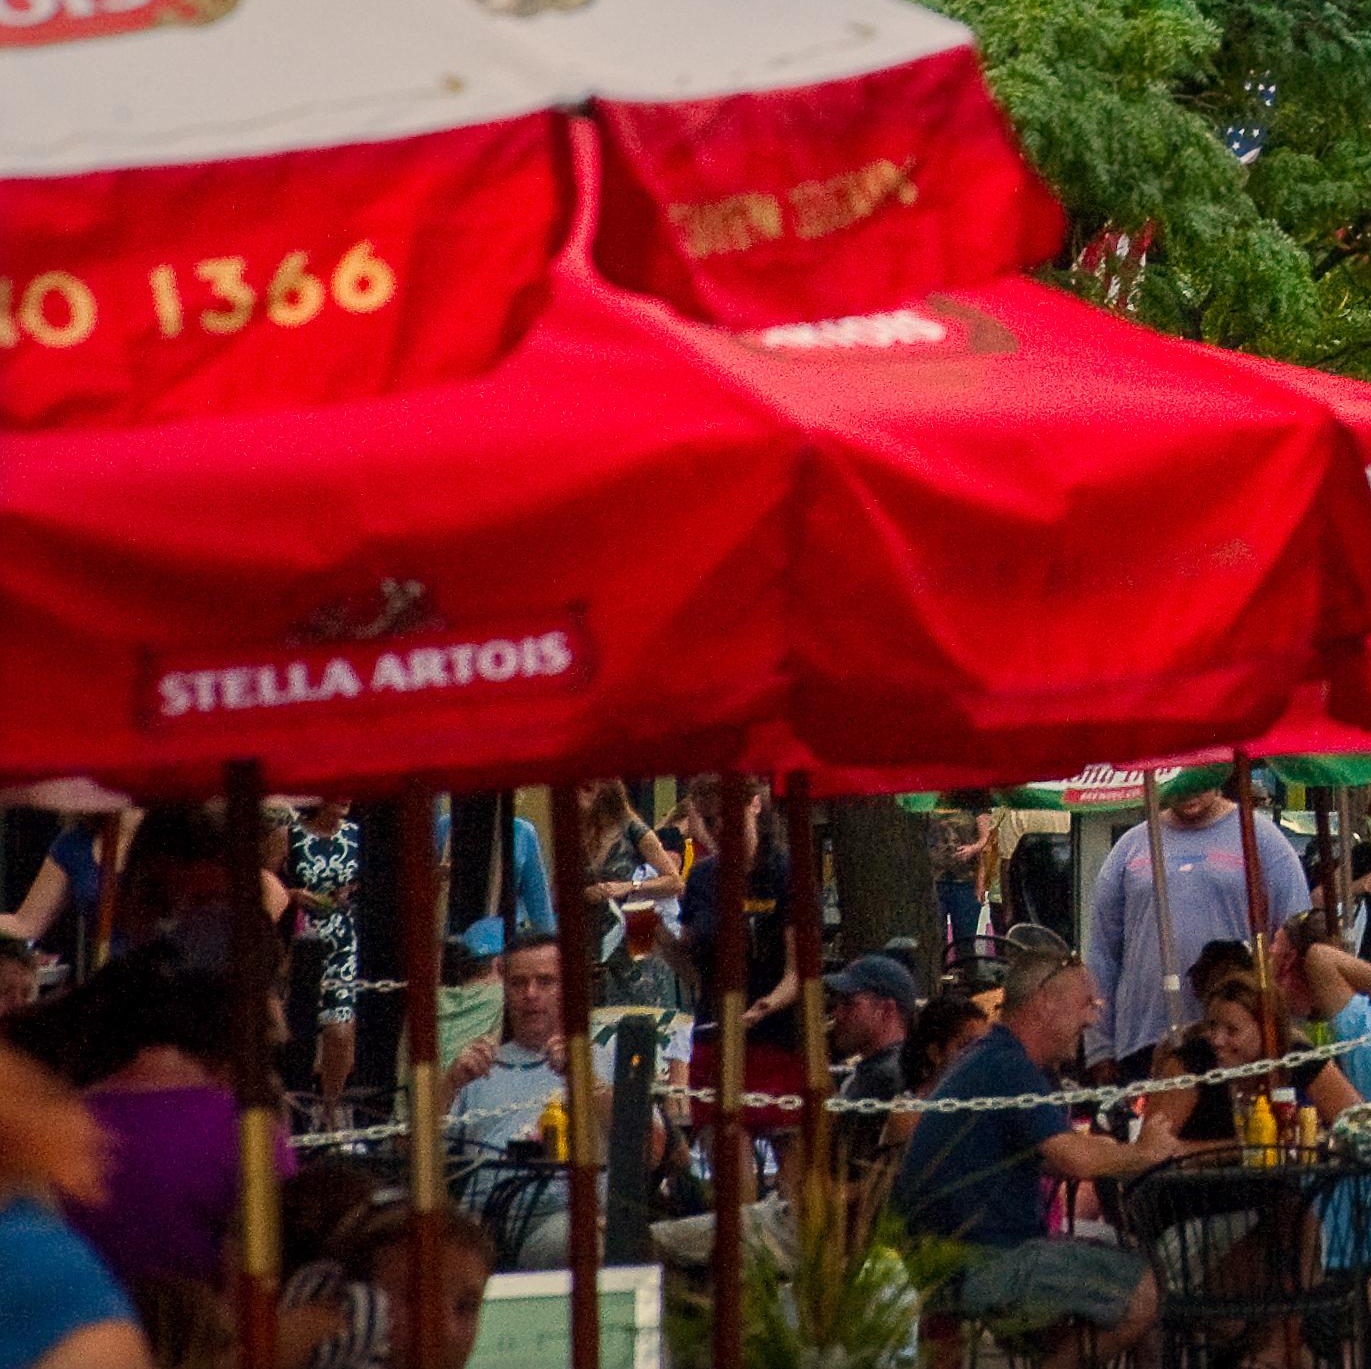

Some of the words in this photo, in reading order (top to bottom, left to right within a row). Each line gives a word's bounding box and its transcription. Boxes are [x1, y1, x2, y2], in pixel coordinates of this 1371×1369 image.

[149, 239, 397, 340] 1366
[157, 658, 362, 718] STELLA
[370, 631, 572, 694] ARTOIS
